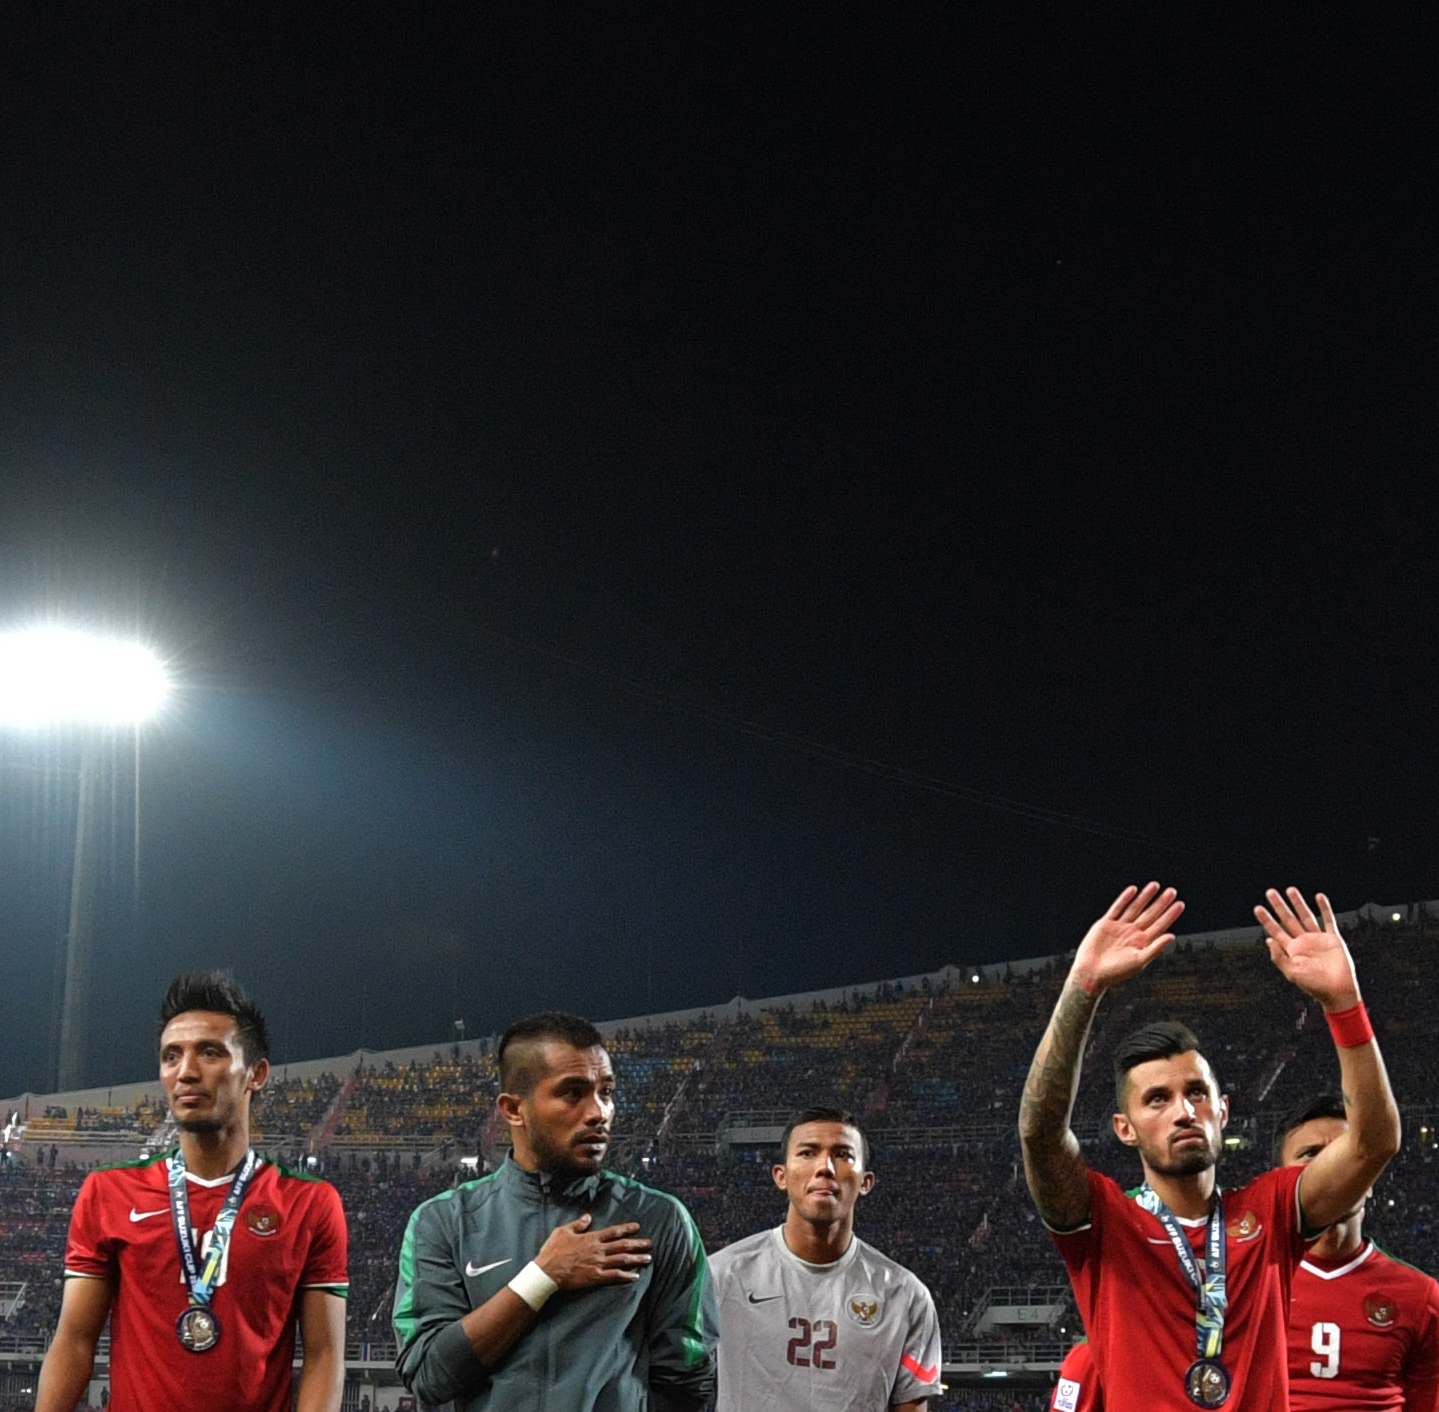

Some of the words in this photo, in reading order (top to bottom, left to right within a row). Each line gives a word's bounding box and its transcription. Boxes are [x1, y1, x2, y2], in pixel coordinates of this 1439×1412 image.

[176, 1215, 192, 1252] SUZUKI
[184, 1252, 196, 1274] CUP
[1172, 1235, 1194, 1273] SUZUKI
[787, 1316, 837, 1370] 22
[1310, 1322, 1340, 1378] 9
